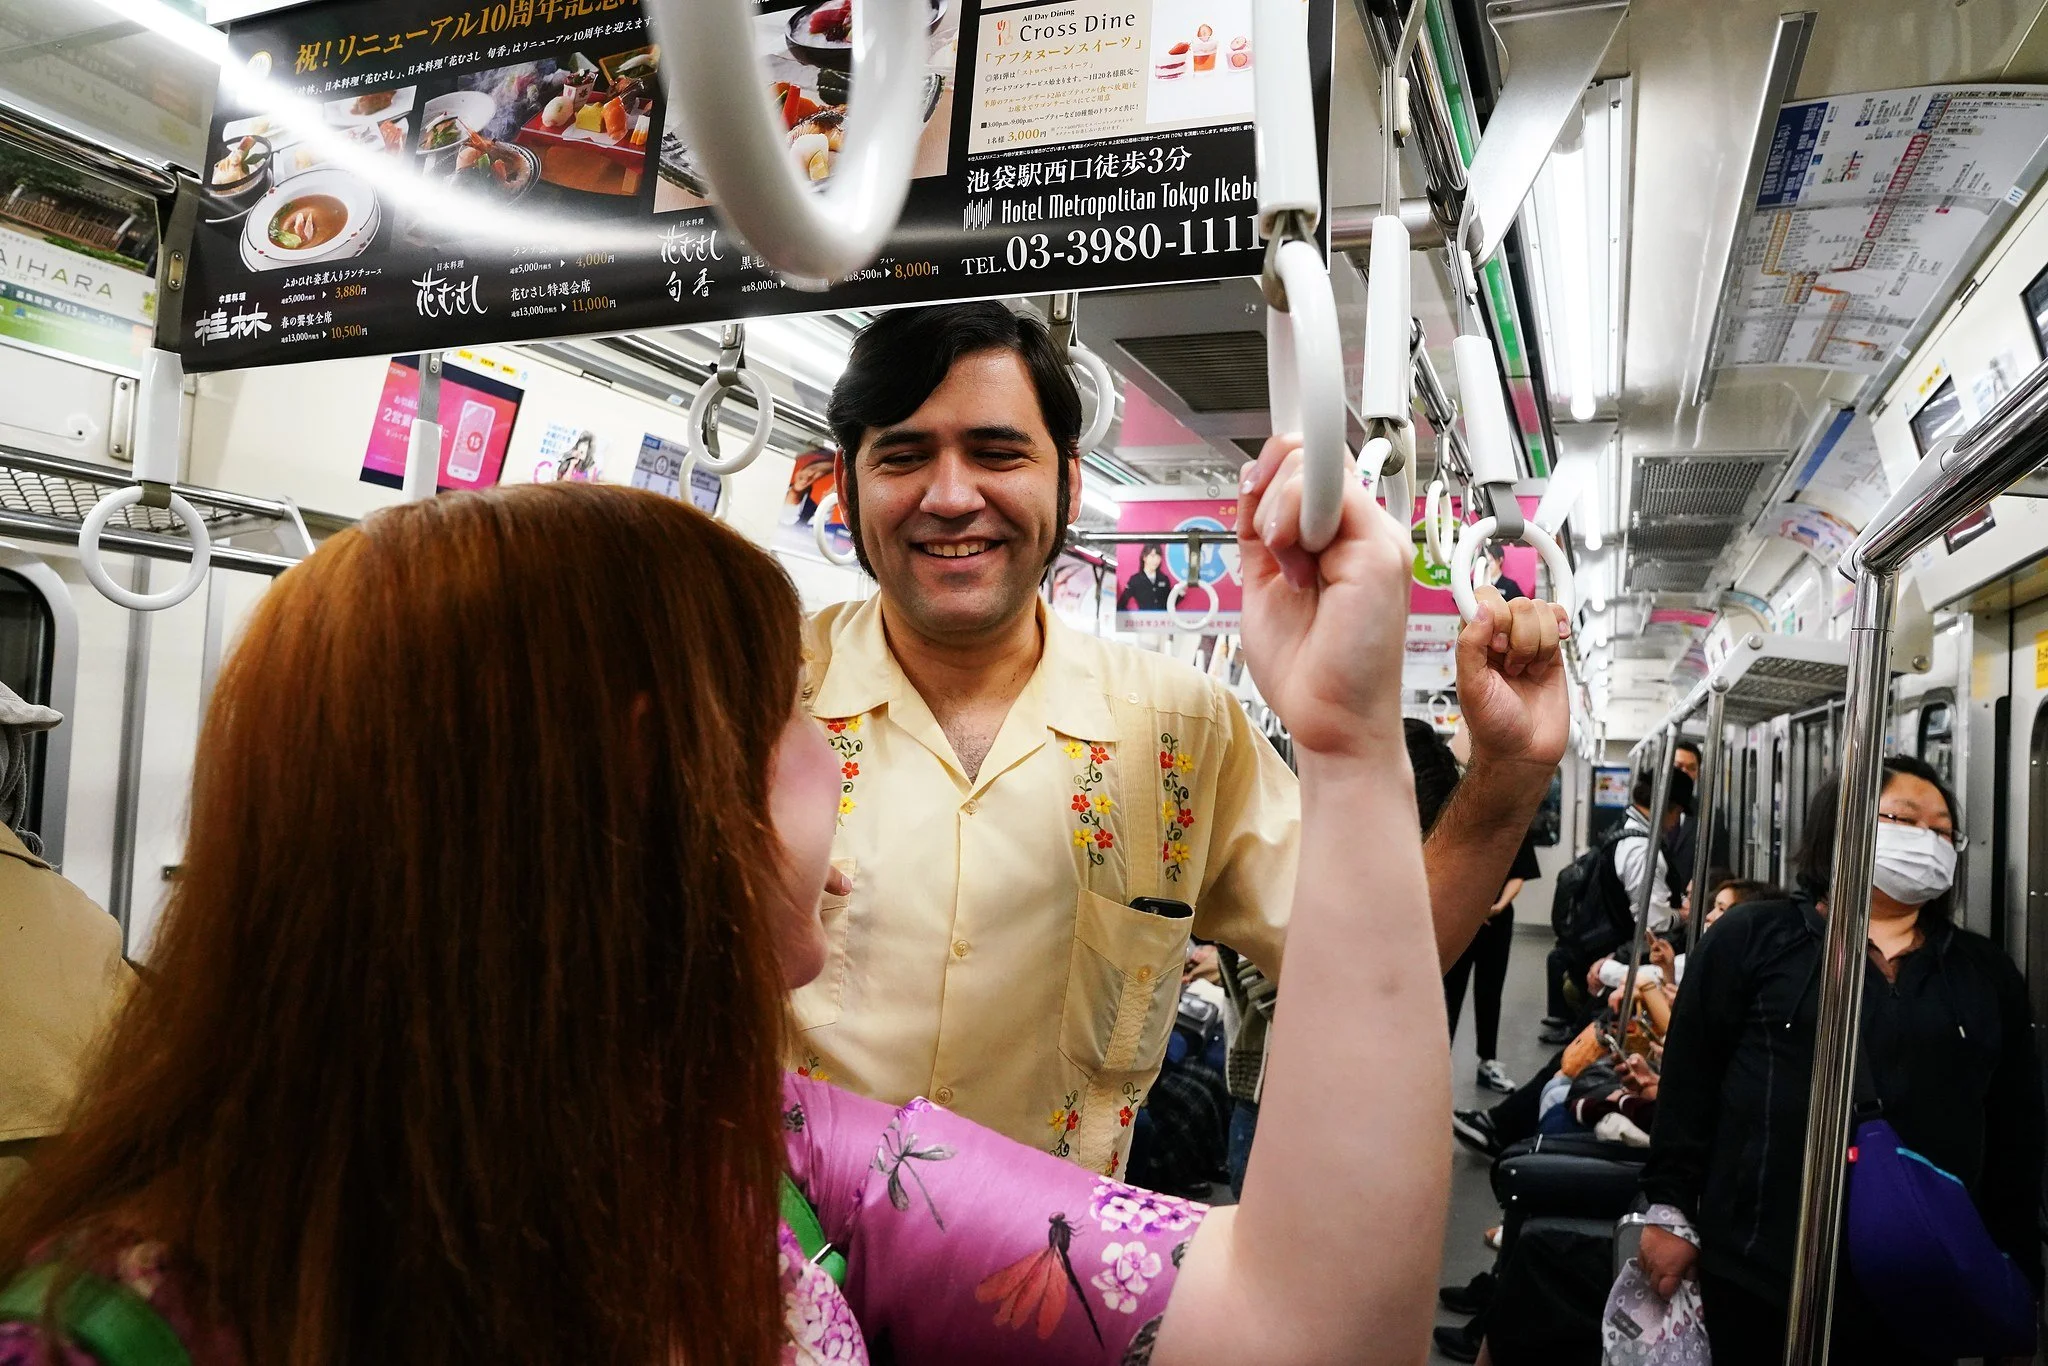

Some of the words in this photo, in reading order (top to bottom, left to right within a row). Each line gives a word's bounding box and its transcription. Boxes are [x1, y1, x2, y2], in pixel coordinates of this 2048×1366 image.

[1022, 14, 1034, 22] All
[1035, 11, 1049, 21] Day
[1050, 9, 1075, 18] Dining
[1019, 22, 1077, 42] Cross
[1085, 13, 1136, 33] Dine
[985, 36, 1142, 67] 「アフタヌーンスイーツ」
[987, 136, 1005, 145] 1名様
[1007, 128, 1047, 143] 3,000円
[966, 145, 1192, 194] 池袋駅西口徒歩3分
[1001, 198, 1043, 224] Hotel
[1049, 187, 1156, 221] Metropolitan
[1161, 181, 1209, 212] Tokyo
[679, 218, 704, 228] 日本料理
[658, 225, 724, 265] 花むさし
[436, 260, 465, 272] 日本料理
[575, 252, 615, 268] 4,000円
[879, 257, 896, 265] フィレ
[895, 261, 939, 279] 8,000円
[335, 284, 367, 299] 3,880円
[411, 268, 488, 318] 花むさし
[510, 278, 591, 302] 花むさし特選会席
[571, 295, 617, 314] 11,000円
[194, 302, 272, 347] 桂林
[331, 325, 368, 340] 10,500円
